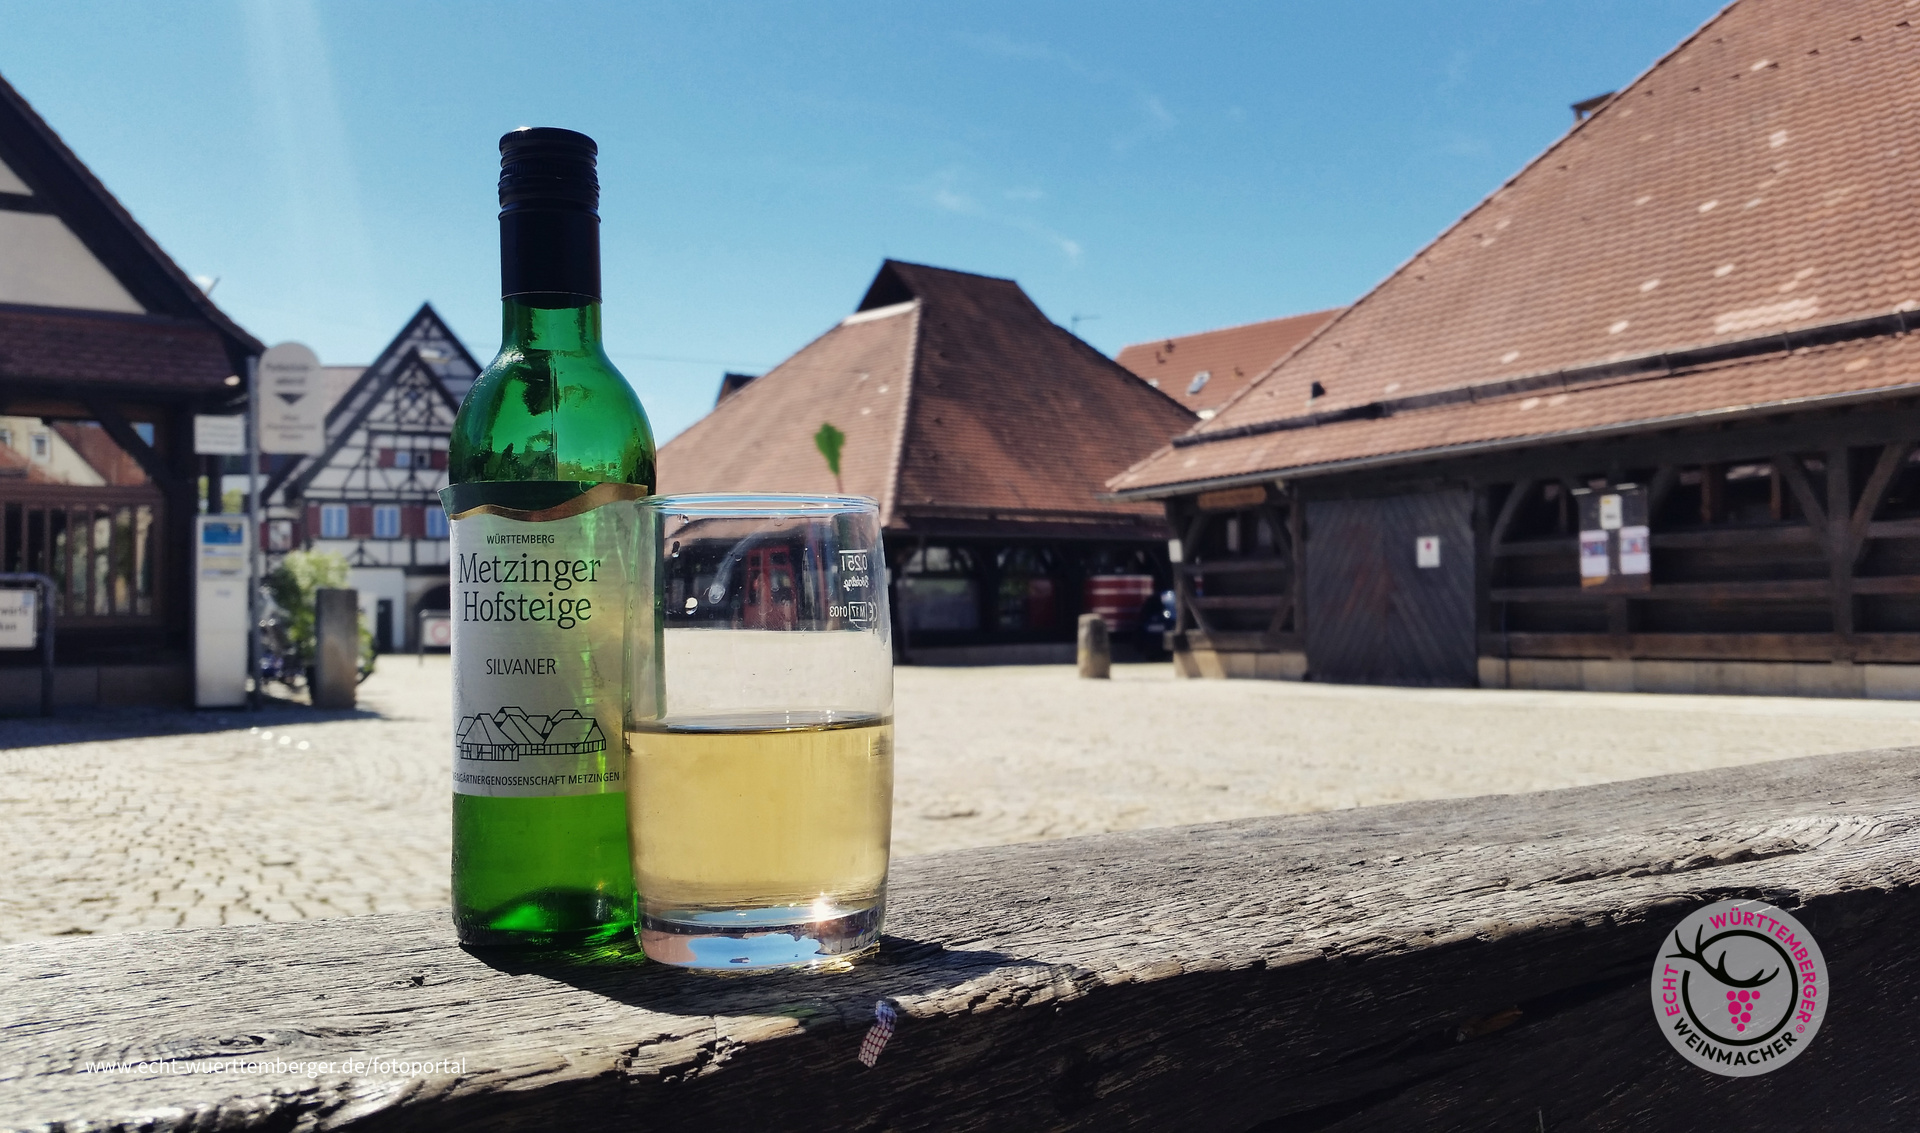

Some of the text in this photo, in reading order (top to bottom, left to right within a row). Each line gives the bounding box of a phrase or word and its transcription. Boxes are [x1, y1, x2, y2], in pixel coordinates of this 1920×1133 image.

[486, 533, 555, 545] WÜRTTEMBERG
[458, 553, 601, 591] Metzinger
[463, 591, 593, 630] Hofsteige
[486, 658, 557, 675] SILVANER
[568, 771, 620, 784] METZINGEN
